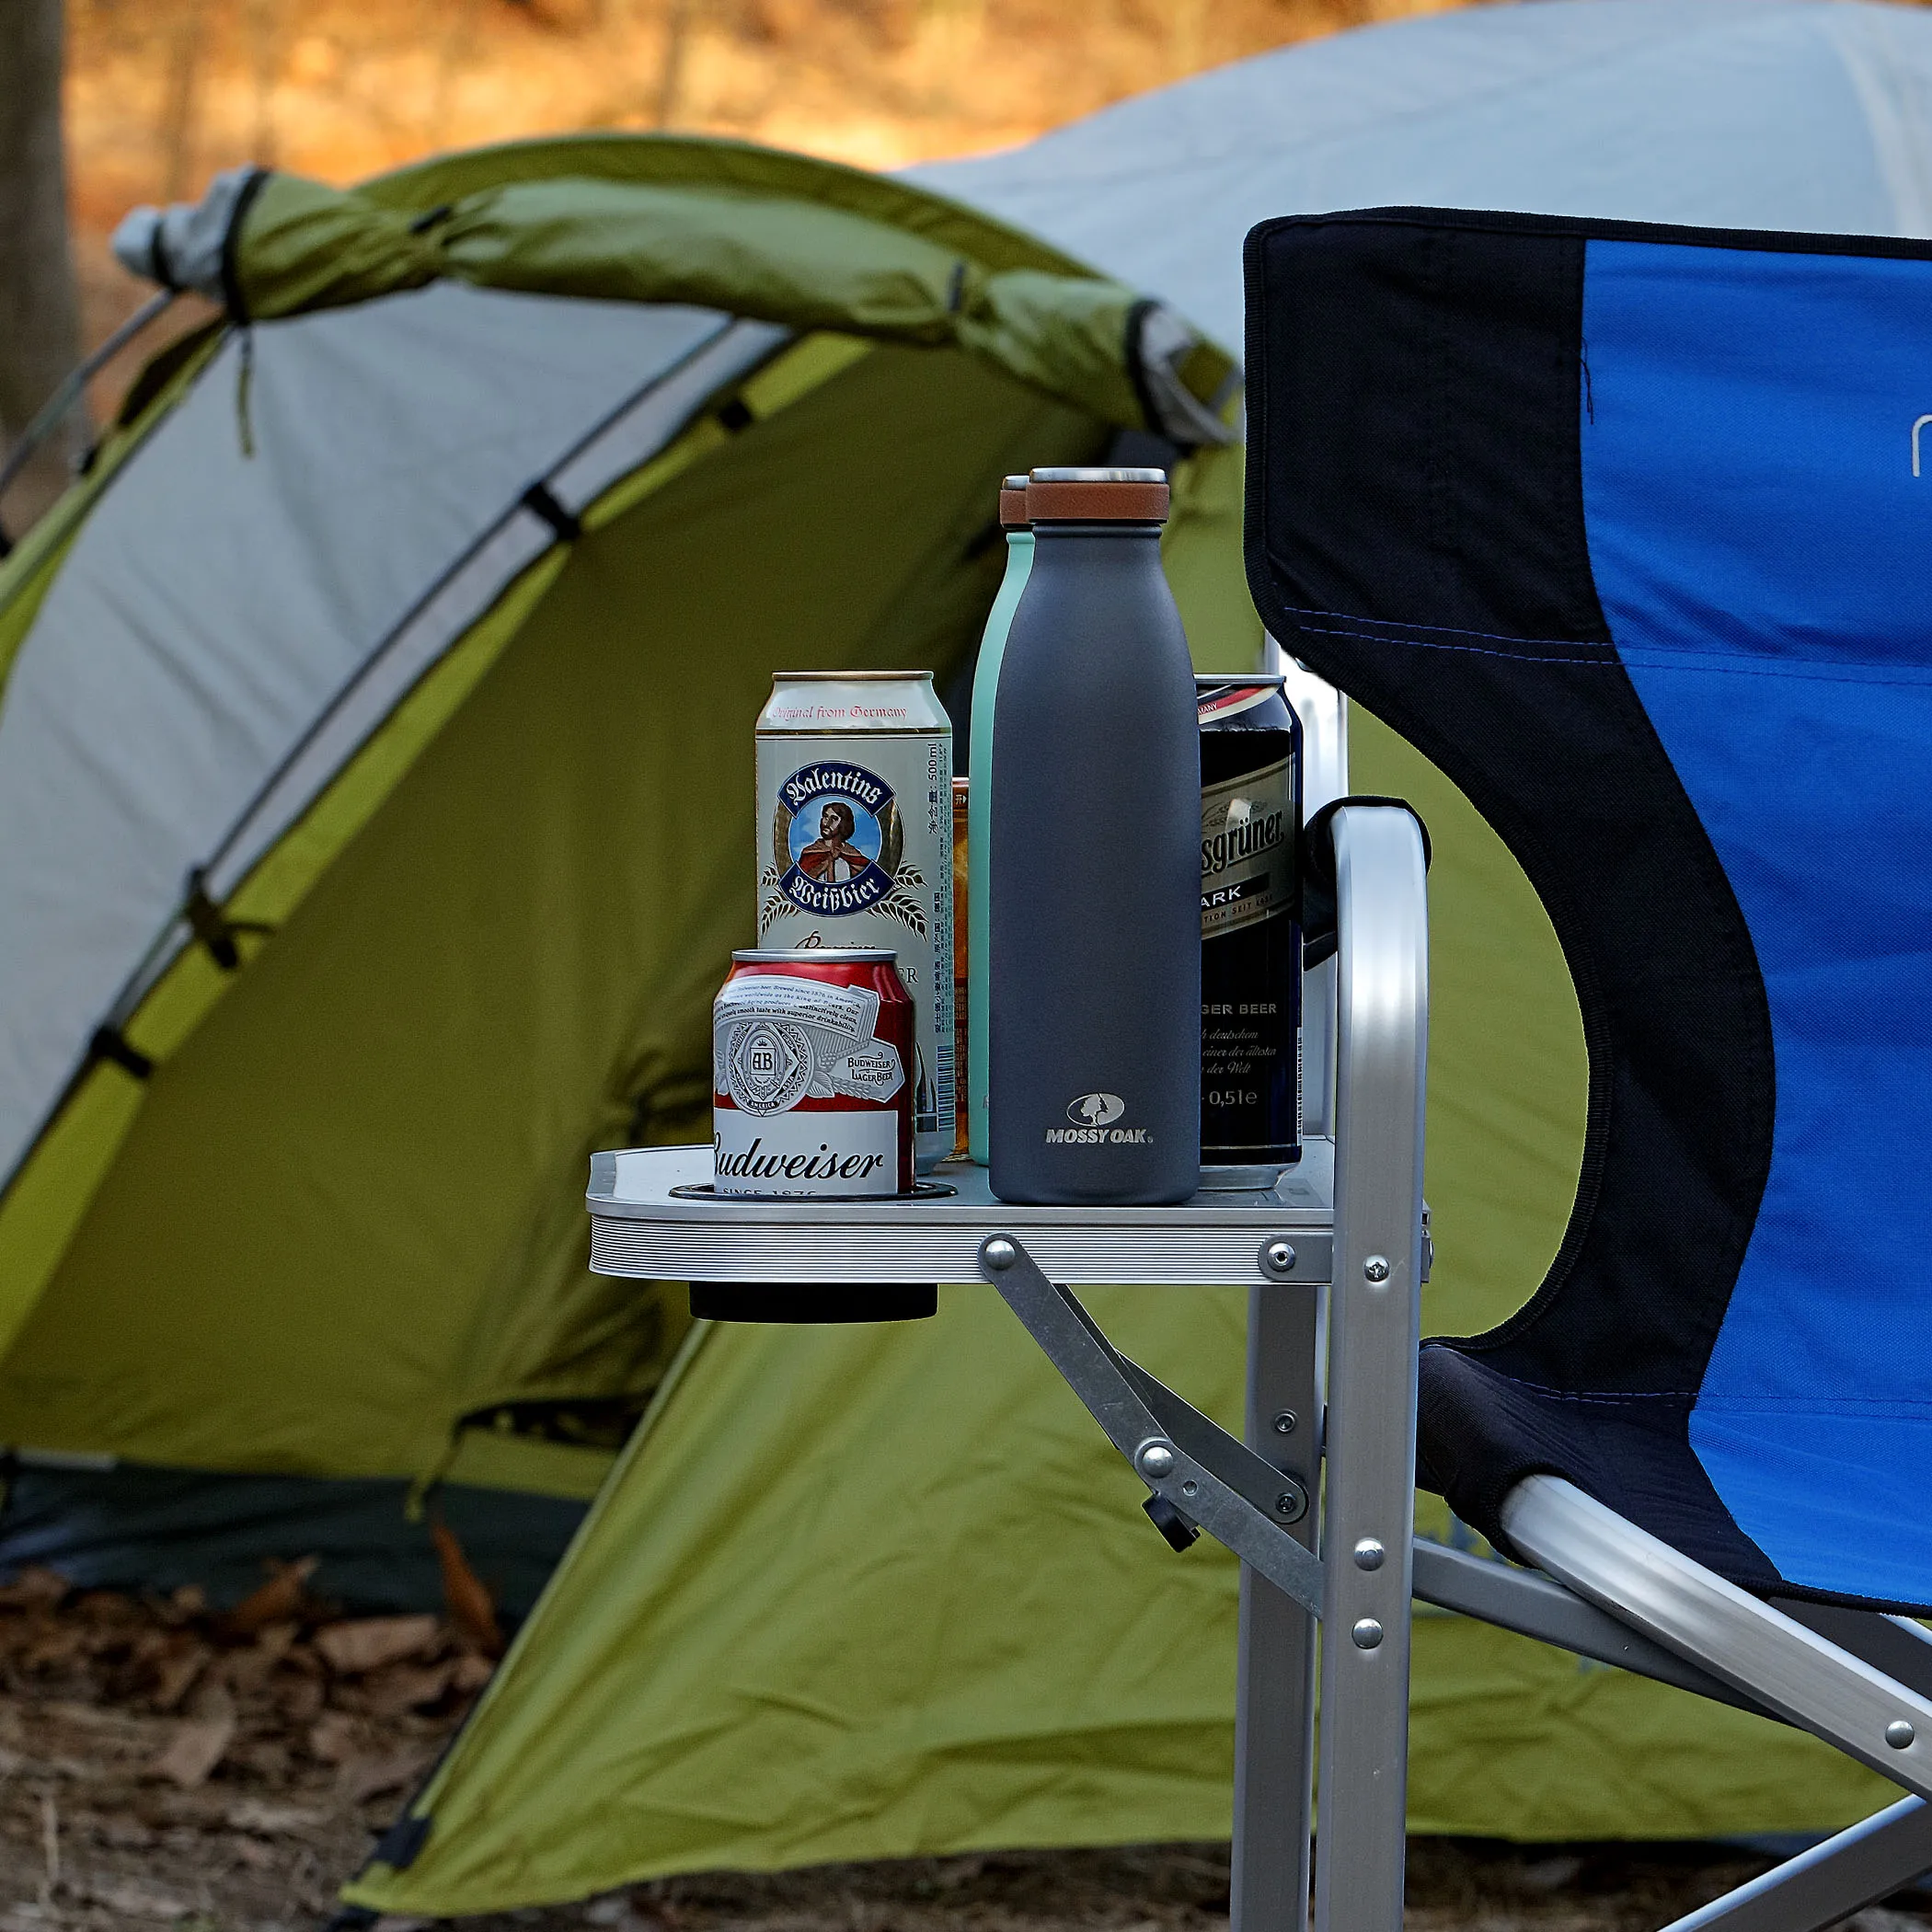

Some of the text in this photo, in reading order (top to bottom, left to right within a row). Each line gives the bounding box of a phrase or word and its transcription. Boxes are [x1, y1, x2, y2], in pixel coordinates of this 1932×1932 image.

[772, 705, 907, 721] Original from Germany
[786, 767, 883, 806] Valentins
[788, 875, 880, 914] Weißbier
[1201, 886, 1241, 907] ARK
[1203, 911, 1226, 923] TION
[1232, 903, 1252, 914] SEIT
[771, 1006, 787, 1015] with
[787, 1010, 816, 1019] superior
[845, 1006, 859, 1016] Our
[1239, 1003, 1278, 1015] BEER
[1045, 1129, 1110, 1144] MOSSY
